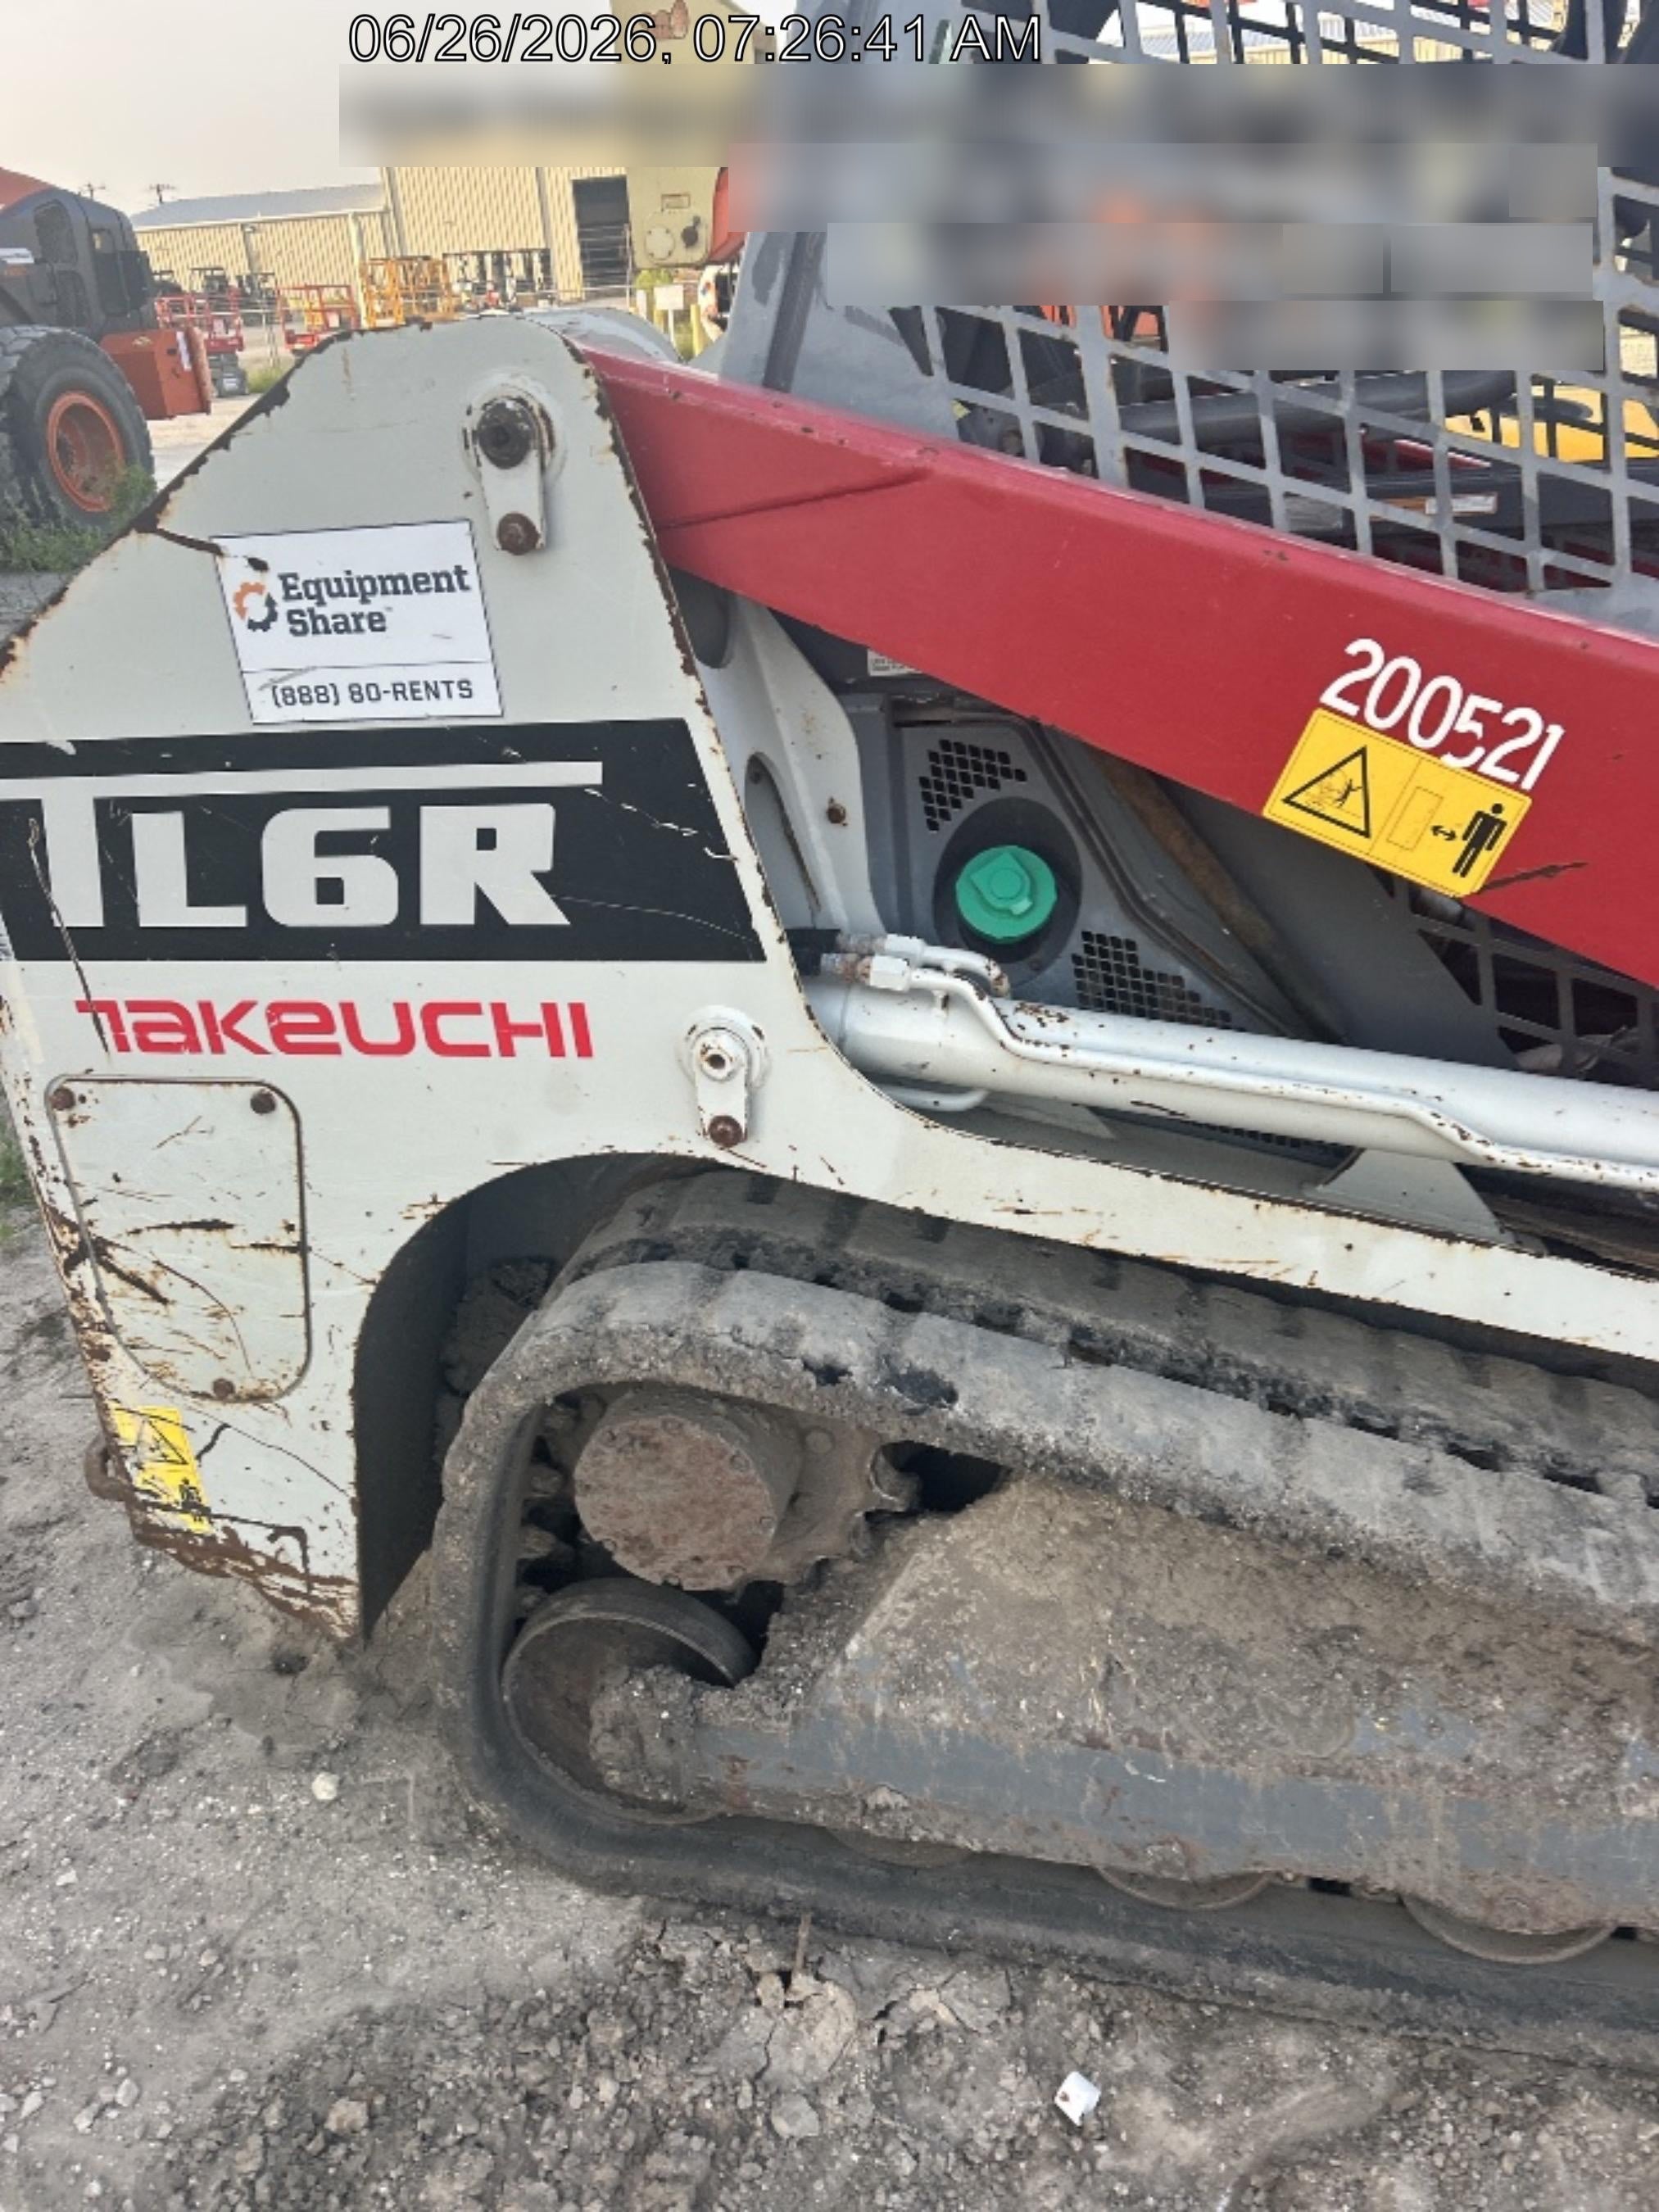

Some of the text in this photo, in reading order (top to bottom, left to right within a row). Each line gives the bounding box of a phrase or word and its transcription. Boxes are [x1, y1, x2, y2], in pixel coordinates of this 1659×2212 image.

[278, 565, 470, 606] Equipment
[287, 607, 387, 637] Share
[271, 679, 473, 707] (888) 80-RENTS
[1320, 638, 1565, 791] 200521
[0, 761, 603, 928] TL6R
